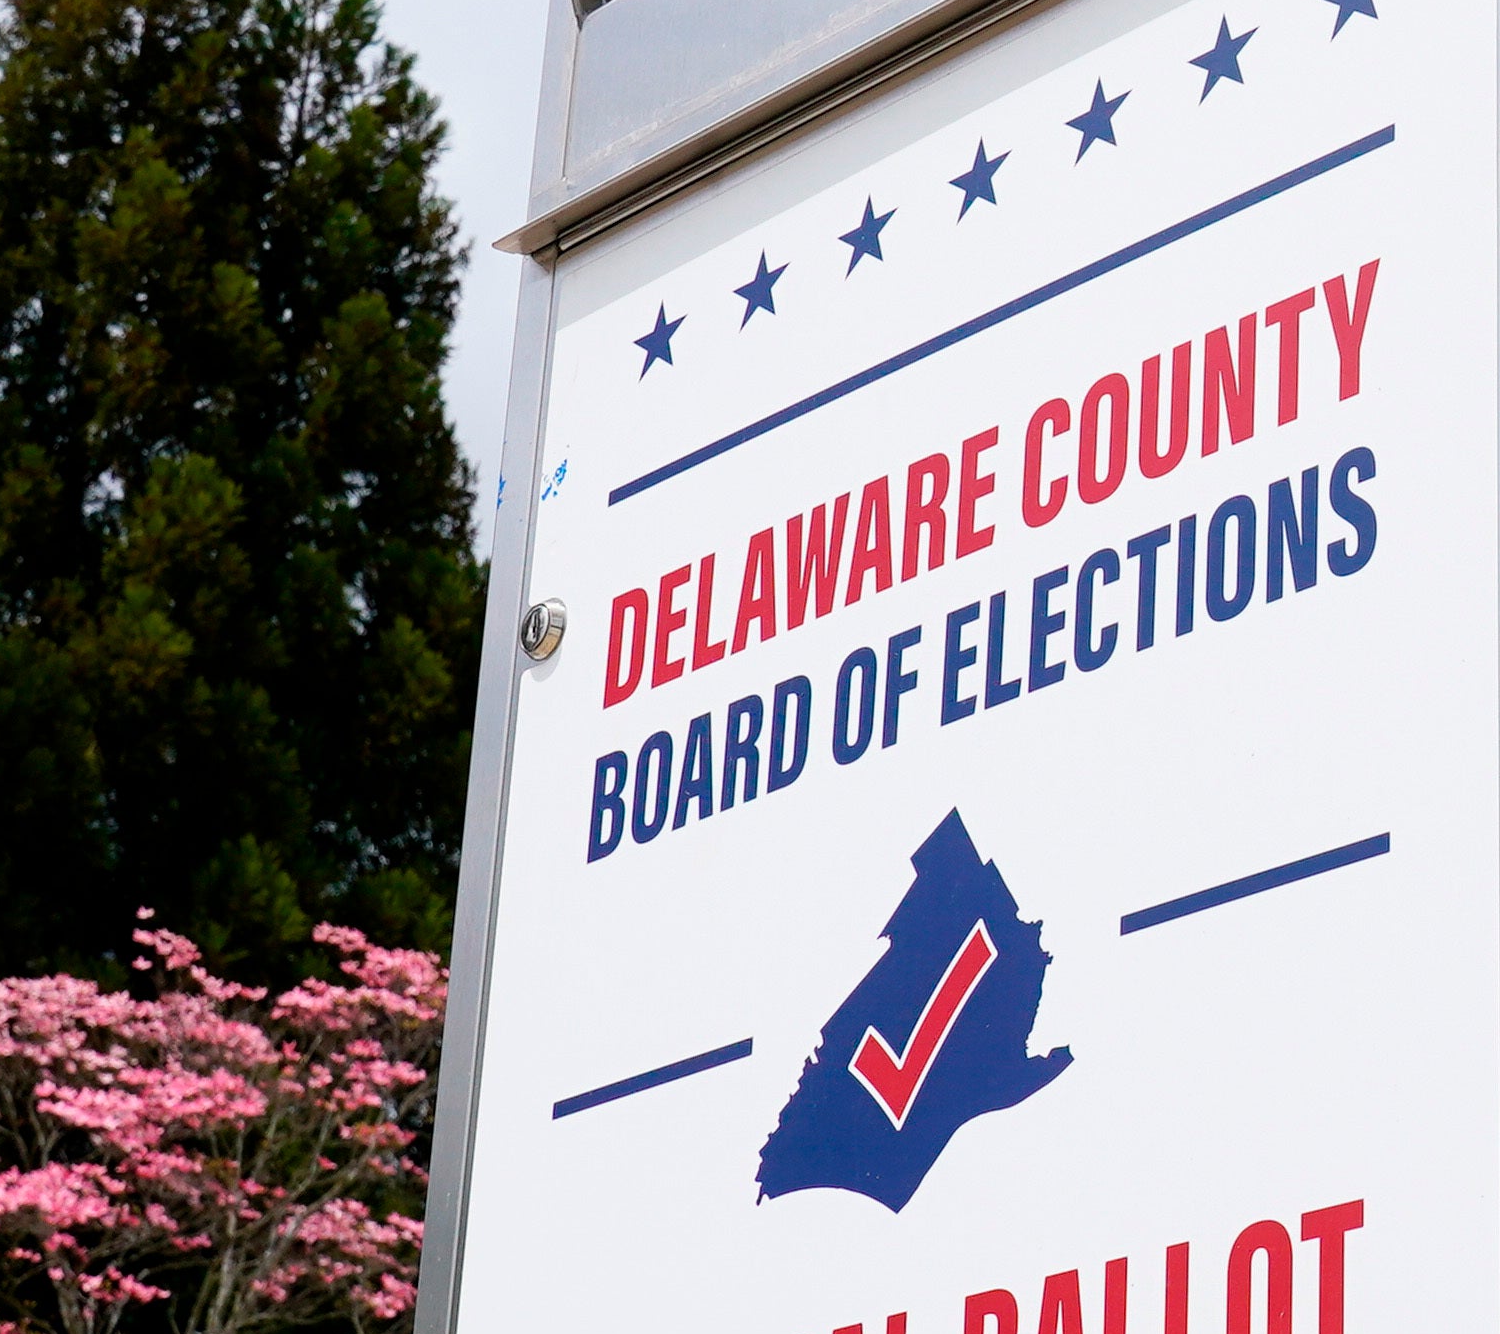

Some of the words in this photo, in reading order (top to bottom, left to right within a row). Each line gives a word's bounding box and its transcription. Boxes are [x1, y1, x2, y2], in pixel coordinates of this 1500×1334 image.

[588, 676, 811, 863] BOARD
[833, 626, 921, 765] OF
[941, 447, 1376, 726] ELECTIONS
[603, 426, 998, 708] DELAWARE
[1022, 259, 1379, 528] COUNTY
